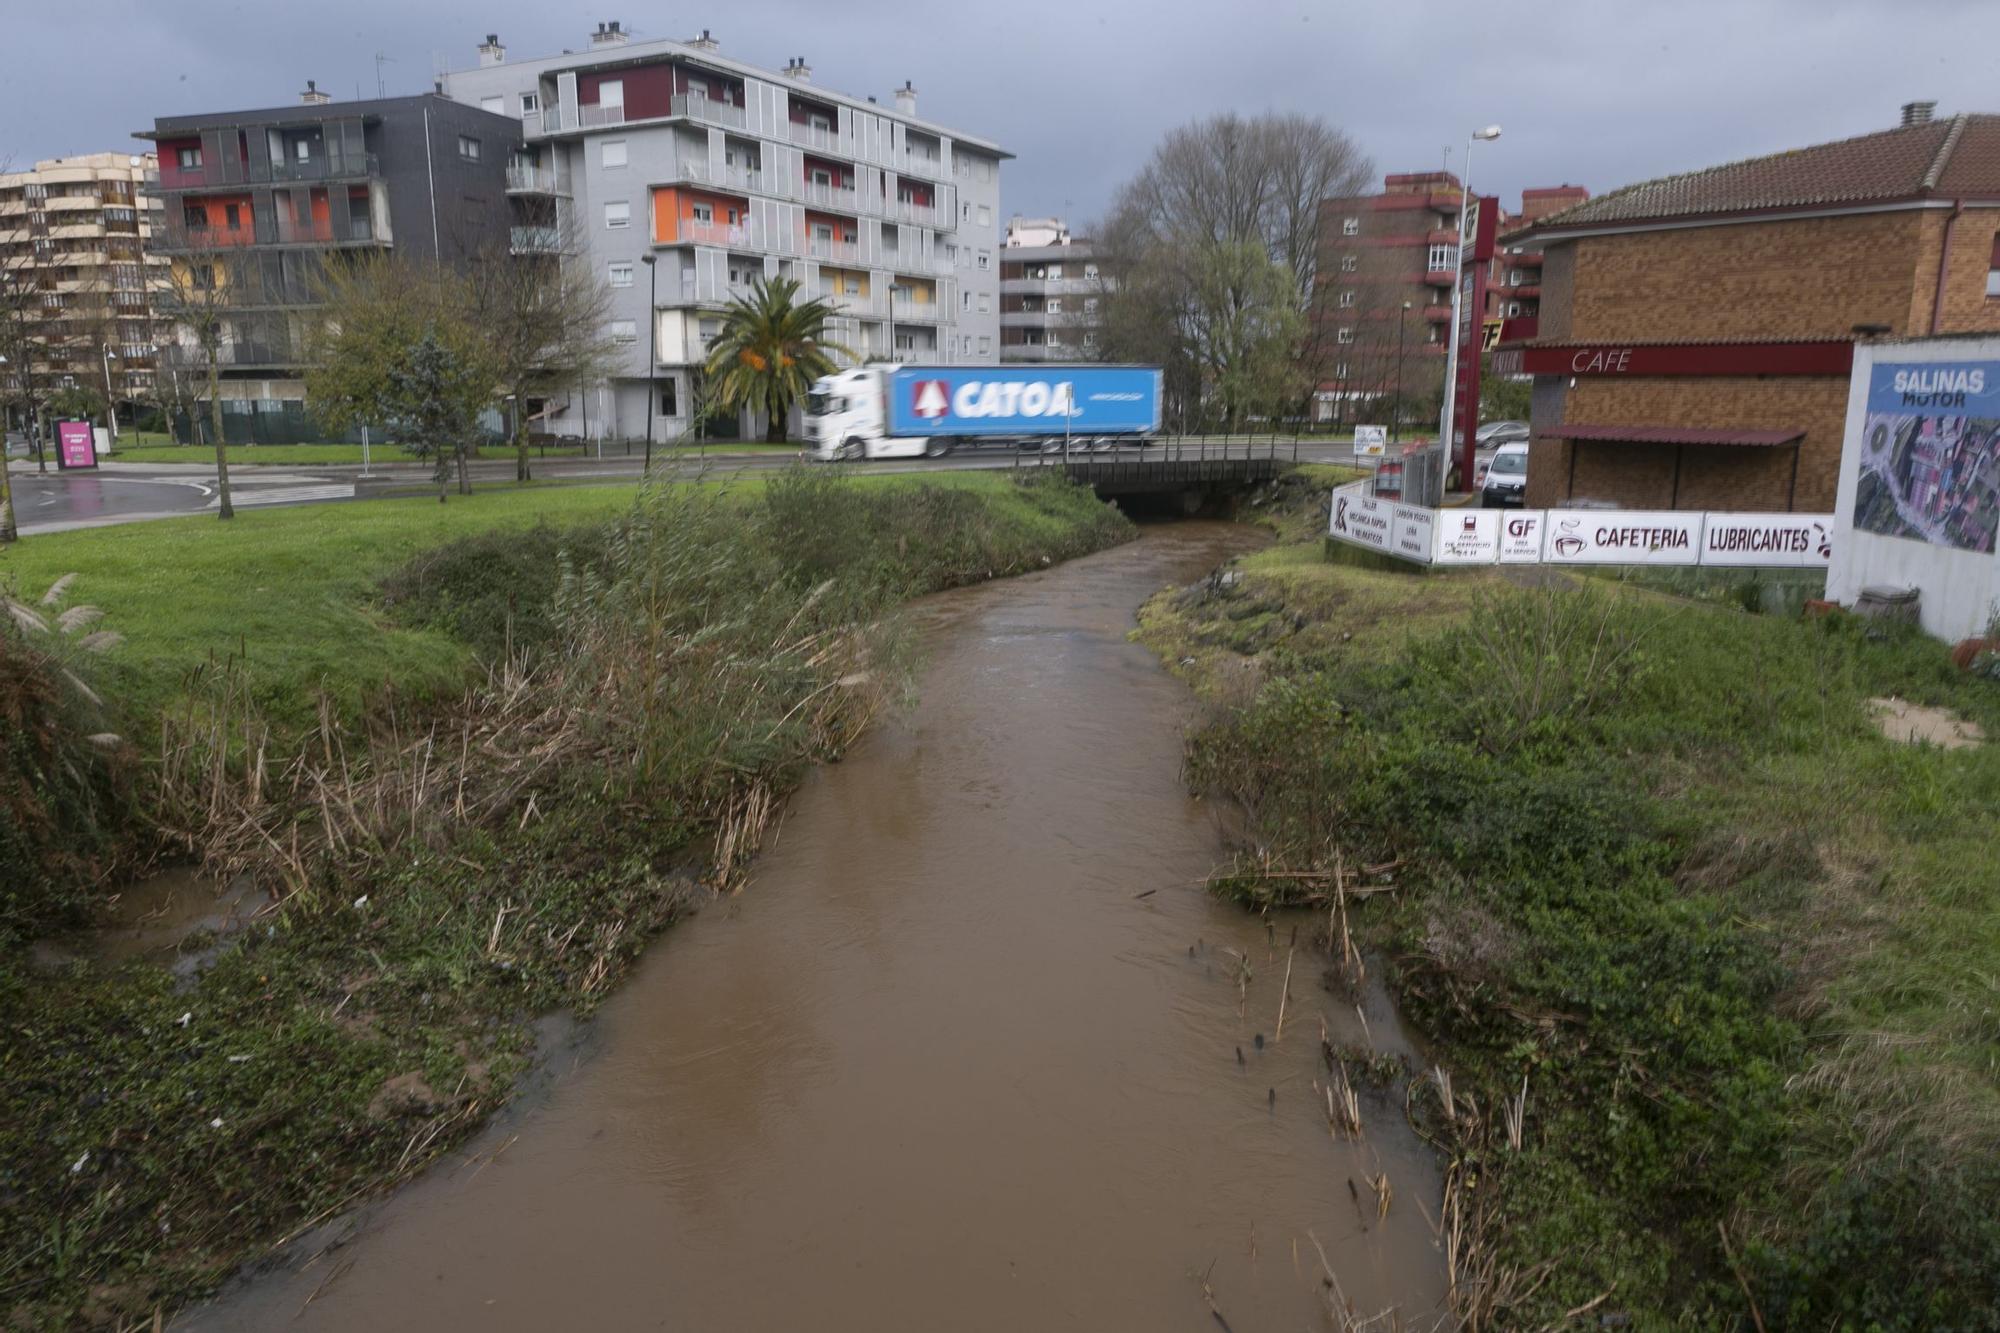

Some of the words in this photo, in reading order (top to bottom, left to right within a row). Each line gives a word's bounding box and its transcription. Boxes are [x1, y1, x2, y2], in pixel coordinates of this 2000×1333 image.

[1572, 349, 1632, 373] CAFE
[1893, 368, 1985, 393] SALINAS
[952, 381, 1078, 418] CATOA
[1902, 391, 1965, 408] MOTOR
[1508, 519, 1536, 536] GF
[1709, 527, 1809, 552] LUBRICANTES
